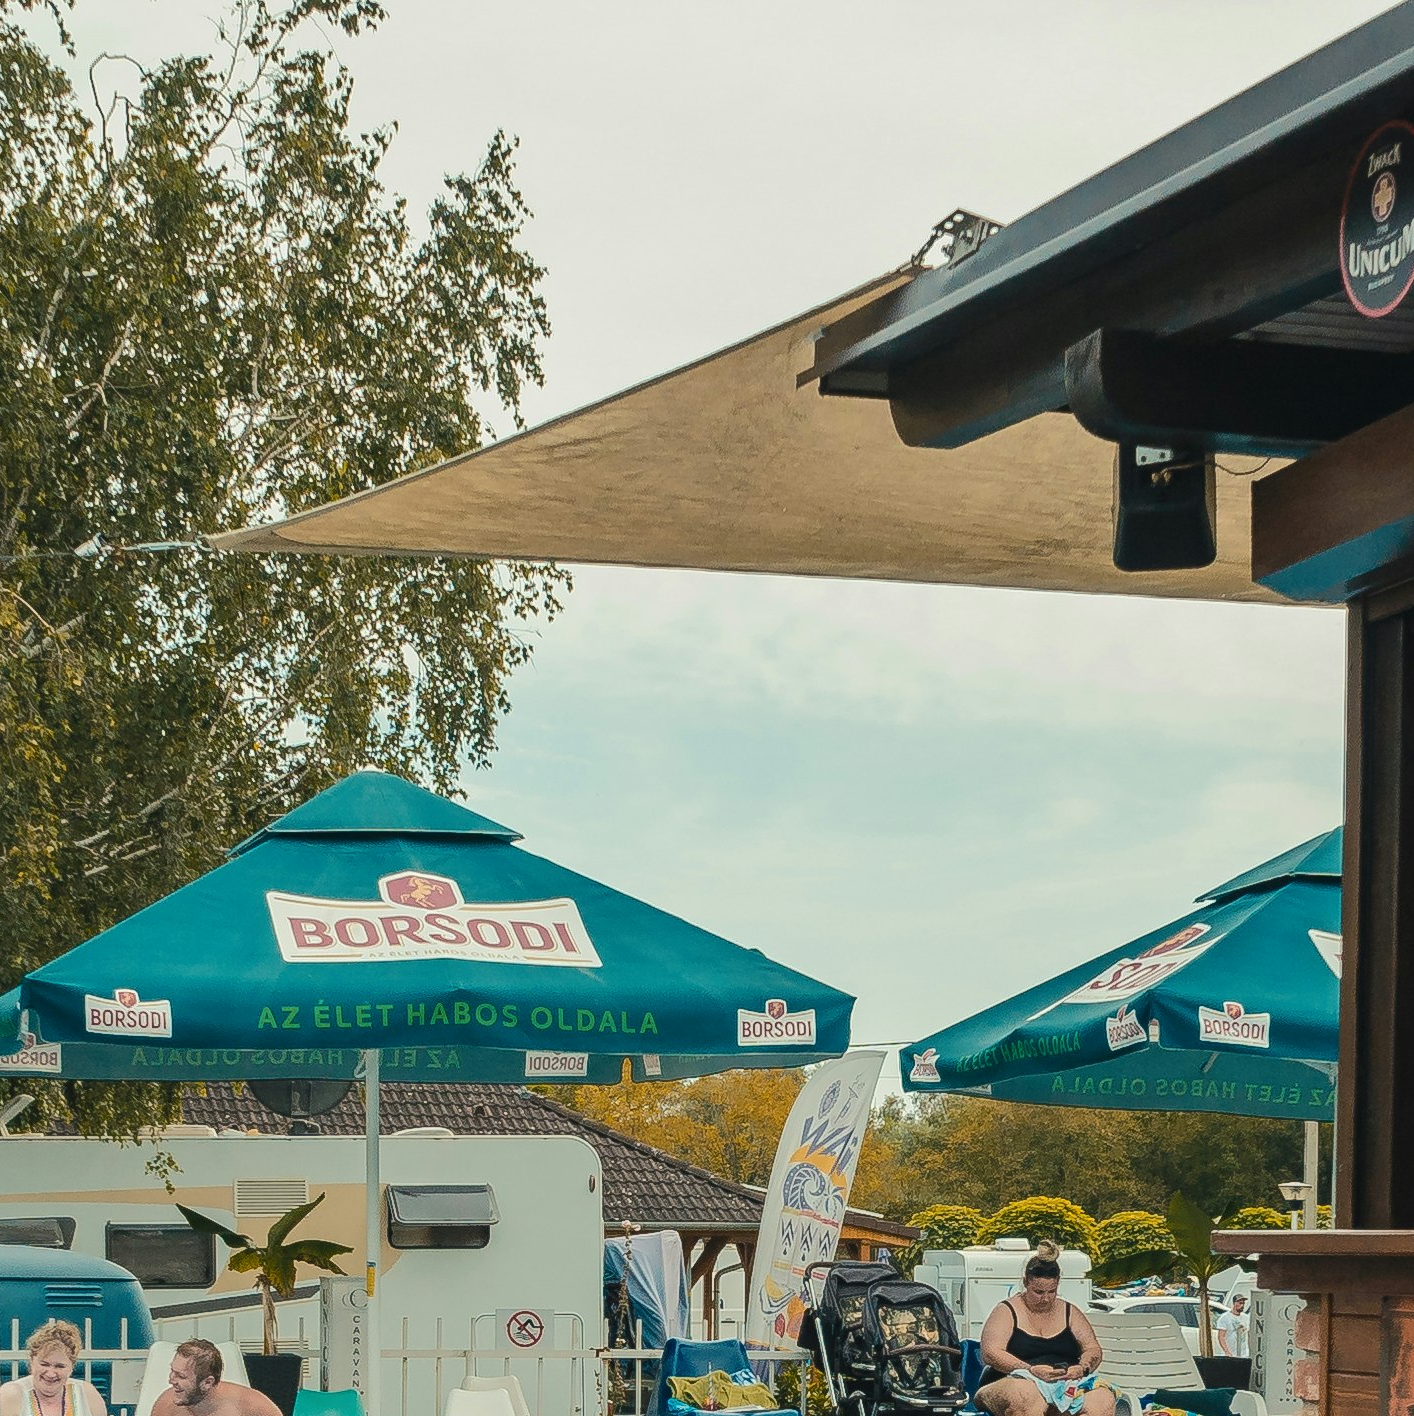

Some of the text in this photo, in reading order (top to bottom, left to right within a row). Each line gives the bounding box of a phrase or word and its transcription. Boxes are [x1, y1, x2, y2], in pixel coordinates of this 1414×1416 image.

[287, 913, 580, 954] BORSODI
[90, 1008, 167, 1030] BORSODI
[258, 998, 659, 1035] AZ ÉLET HABOS OLDALA
[742, 1020, 813, 1038] BORSODI
[1203, 1019, 1266, 1041] BORSODI
[352, 1315, 360, 1388] CARAVAN
[1286, 1328, 1295, 1396] CARAVAN
